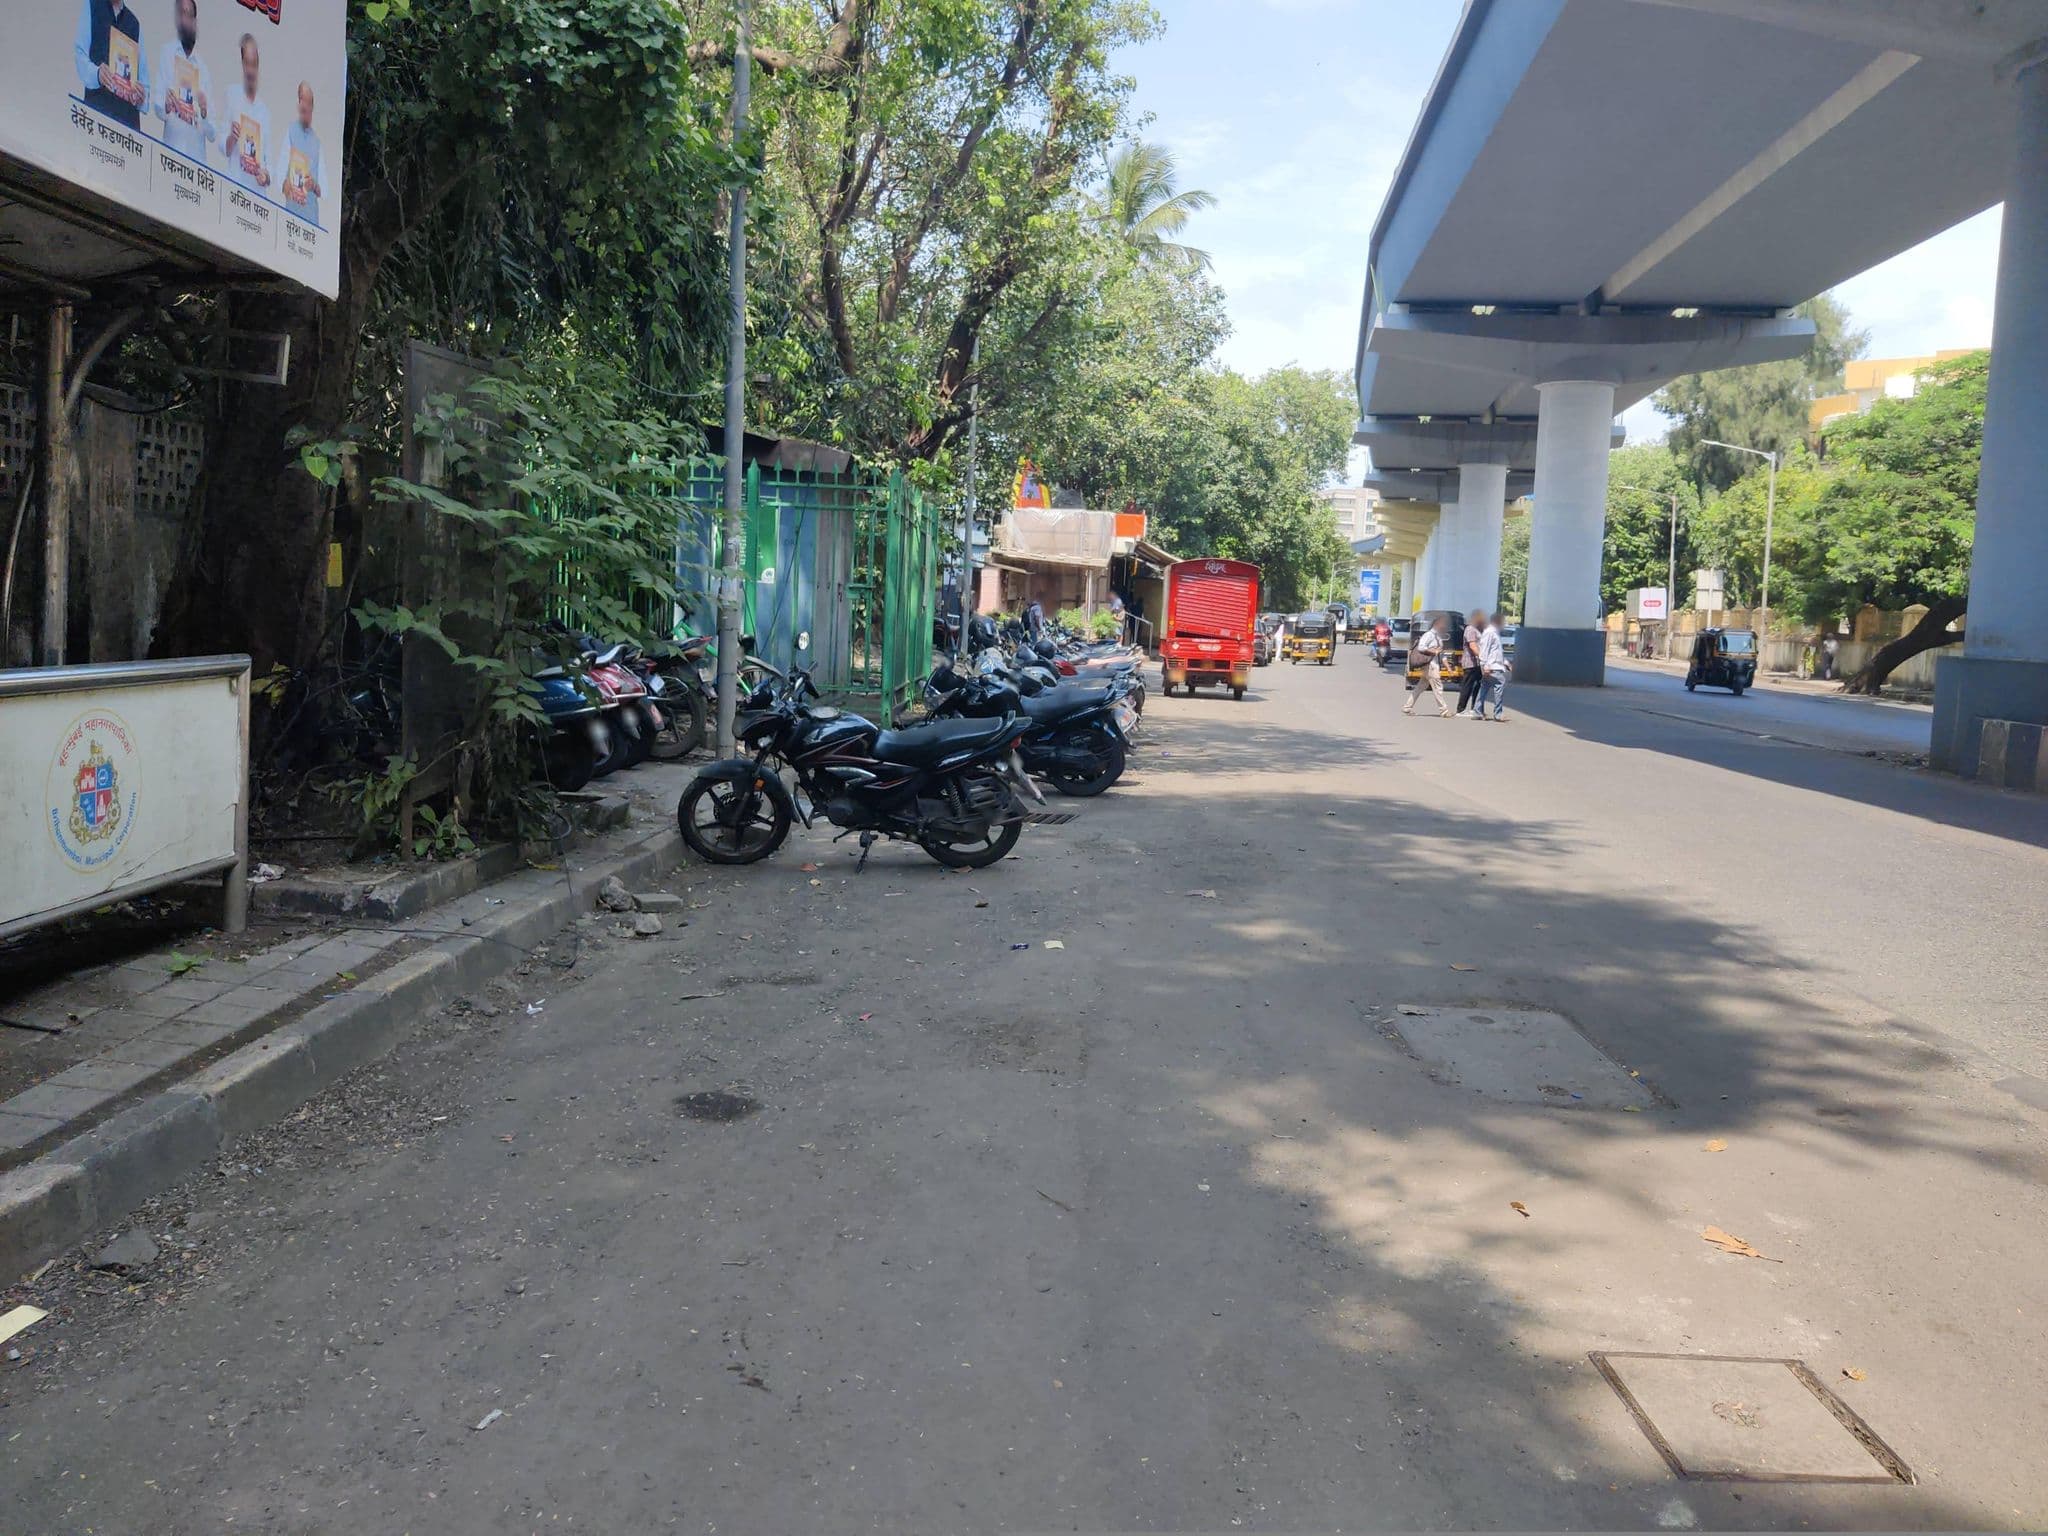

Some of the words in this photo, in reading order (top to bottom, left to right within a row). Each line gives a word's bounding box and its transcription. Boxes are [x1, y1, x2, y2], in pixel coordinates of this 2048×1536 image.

[70, 104, 95, 136] देवेंद्र
[98, 122, 144, 158] फडणवीस
[160, 153, 195, 183] एकनाथ
[197, 168, 215, 195] शिंदे
[229, 190, 252, 214] अजित
[253, 203, 270, 222] पवार
[115, 792, 137, 846] Corporation
